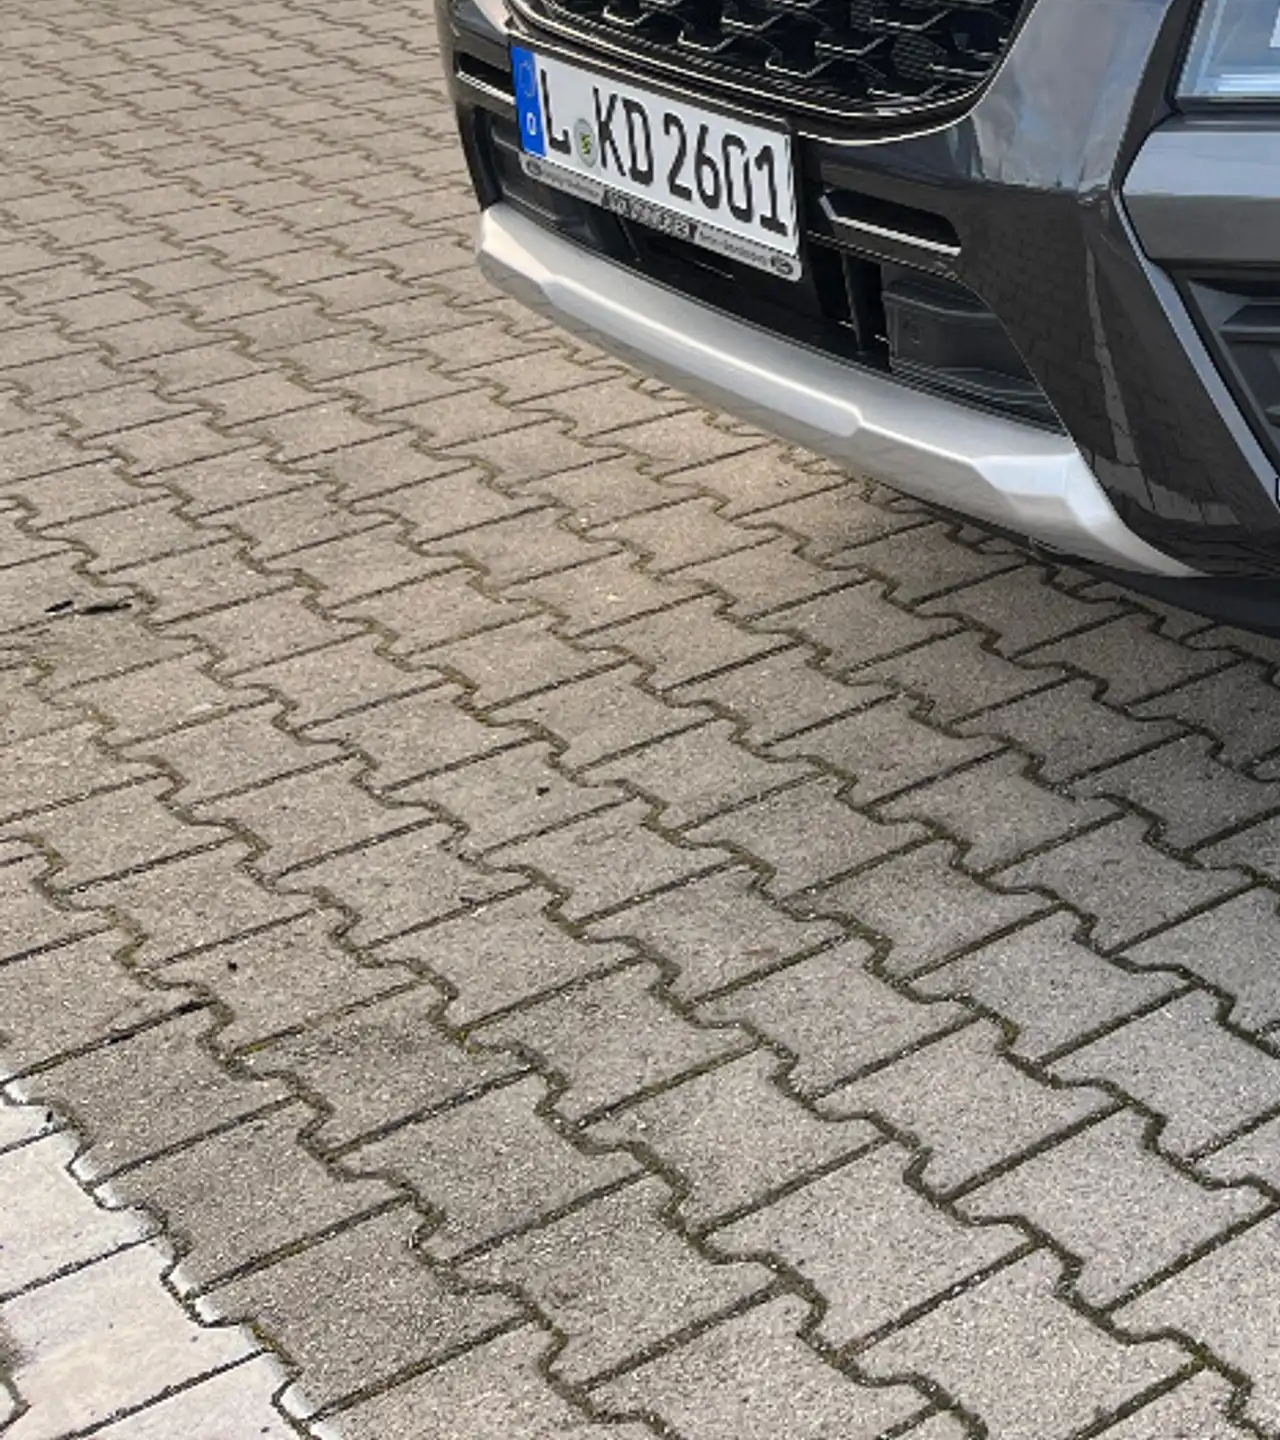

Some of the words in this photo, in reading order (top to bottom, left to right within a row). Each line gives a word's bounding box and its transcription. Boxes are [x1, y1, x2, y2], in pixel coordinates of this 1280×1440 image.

[541, 68, 571, 155] L
[593, 85, 654, 187] KD
[664, 112, 788, 237] 2601
